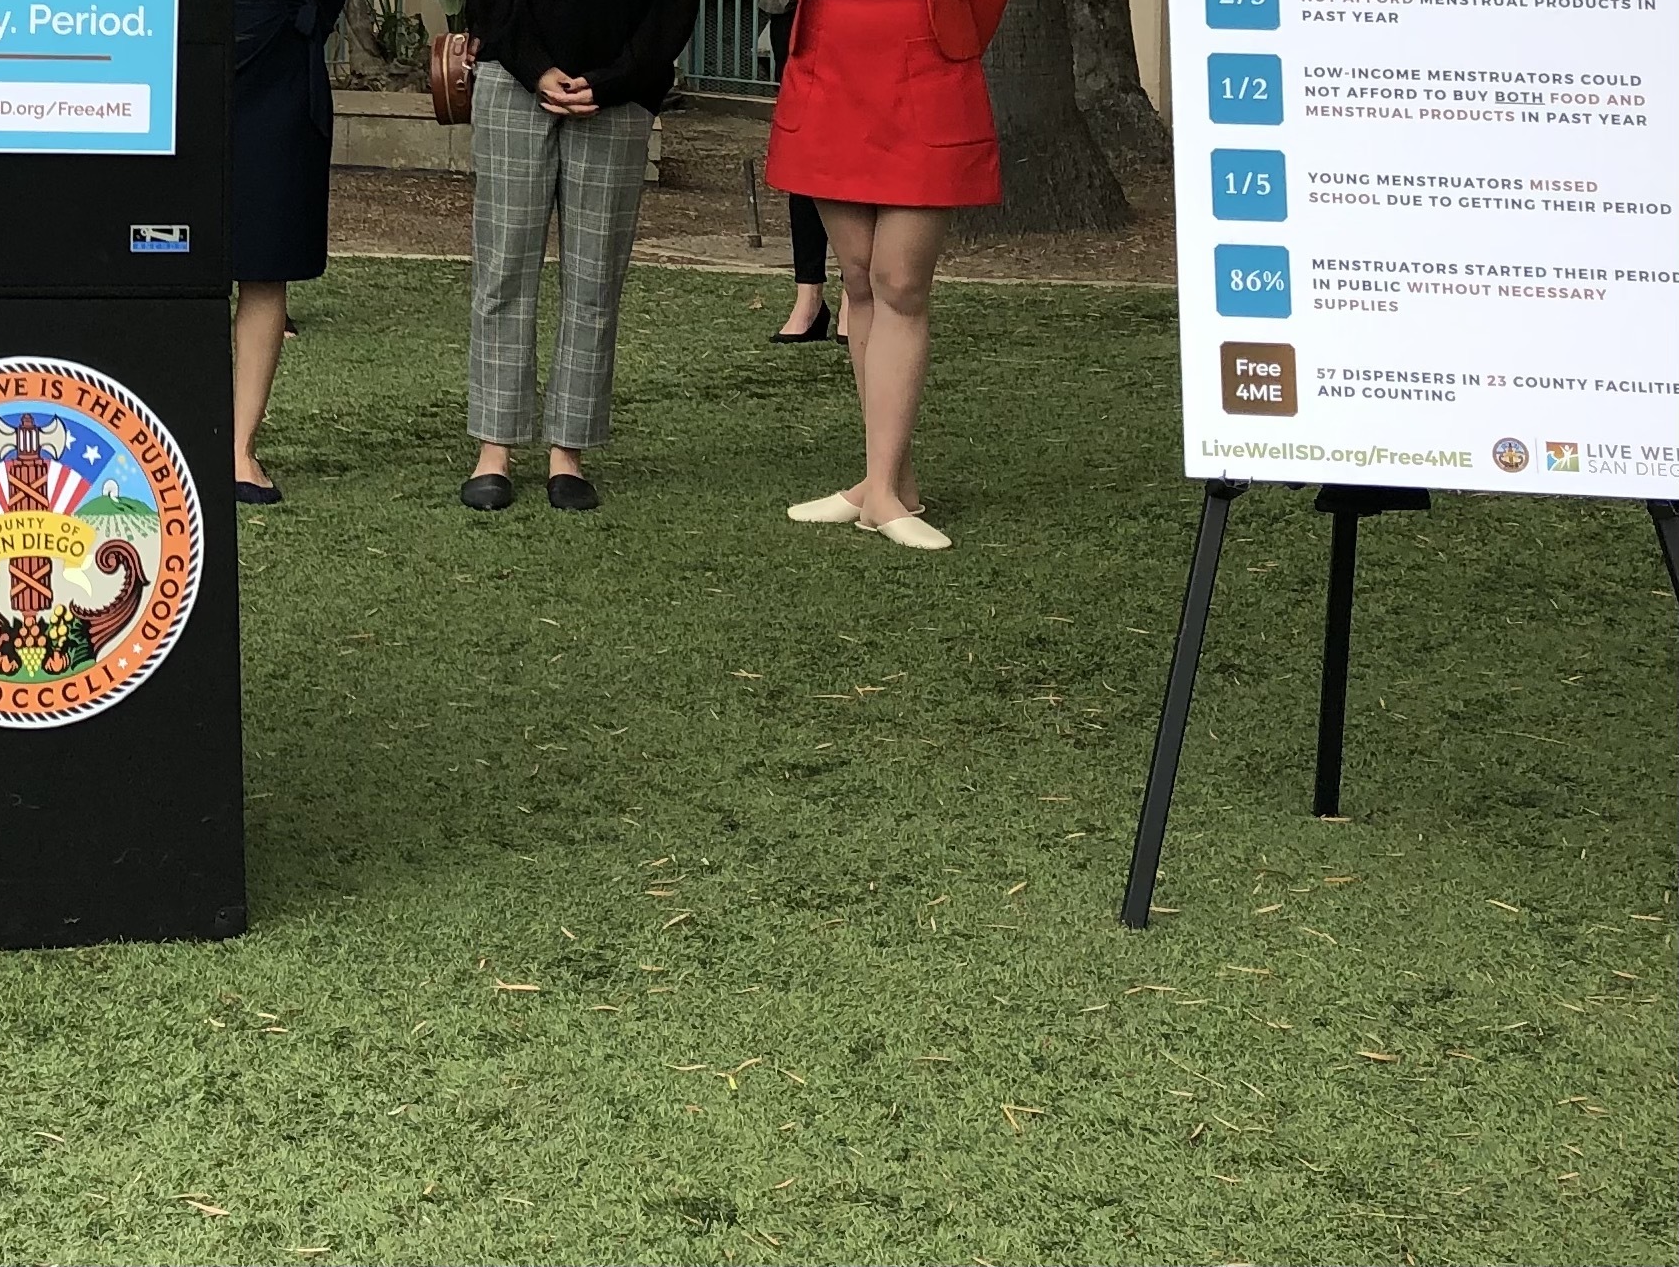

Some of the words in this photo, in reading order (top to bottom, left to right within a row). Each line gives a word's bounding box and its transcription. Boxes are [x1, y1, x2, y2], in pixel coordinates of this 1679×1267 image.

[28, 2, 154, 38] Period.
[1301, 9, 1346, 22] PAST
[1351, 10, 1400, 24] YEAR
[1303, 66, 1422, 82] LOW-INCOME
[1427, 68, 1576, 85] MENSTRUATORS
[1580, 73, 1643, 87] COULD
[1221, 75, 1269, 102] 1/2
[1304, 85, 1341, 98] NOT
[1346, 86, 1418, 101] AFFORD
[1423, 87, 1447, 101] TO
[1452, 89, 1488, 102] BUY
[1494, 90, 1545, 105] BOTH
[1550, 92, 1601, 106] FOOD
[1606, 94, 1646, 107] AND
[1305, 104, 1414, 120] MENSTRUAL
[1419, 107, 1516, 122] PRODUCTS
[1521, 110, 1541, 123] IN
[1546, 111, 1593, 125] PAST
[1598, 113, 1648, 127] YEAR
[1223, 170, 1272, 196] 1/5
[1307, 171, 1371, 186] YOUNG
[1376, 174, 1523, 191] MENSTRUATORS
[1529, 179, 1599, 193] MISSED
[1308, 191, 1381, 206] SCHOOL
[1386, 193, 1423, 207] DUE
[1428, 194, 1452, 208] TO
[1457, 195, 1536, 211] GETTING
[1540, 199, 1596, 213] THEIR
[1601, 201, 1673, 215] PERIOD
[1229, 268, 1285, 293] 86%
[1311, 258, 1458, 275] MENSTRUATORS
[1464, 263, 1547, 279] STARTED
[1552, 266, 1609, 281] THEIR
[1312, 278, 1332, 290] IN
[1337, 279, 1401, 293] PUBLIC
[1407, 281, 1492, 297] WITHOUT
[1497, 285, 1607, 301] NECESSARY
[1313, 298, 1400, 313] SUPPLIES
[1235, 359, 1282, 377] Free
[1316, 367, 1337, 380] 57
[1342, 368, 1457, 385] DISPENSERS
[1461, 373, 1481, 386] IN
[1486, 374, 1508, 387] 23
[1512, 375, 1589, 391] COUNTY
[40, 377, 64, 400] IS
[1235, 384, 1284, 402] 4ME
[1316, 385, 1357, 398] AND
[1361, 387, 1457, 402] COUNTING
[76, 387, 128, 430] THE
[1201, 439, 1473, 468] LiveWellSD.org/Free4ME
[1586, 443, 1632, 460] LIVE
[1640, 445, 1679, 462] WE
[1588, 459, 1627, 475] SAN
[129, 428, 185, 537] PUBLIC
[60, 522, 80, 537] OF
[22, 532, 86, 558] DIEGO
[140, 555, 184, 642] GOOD
